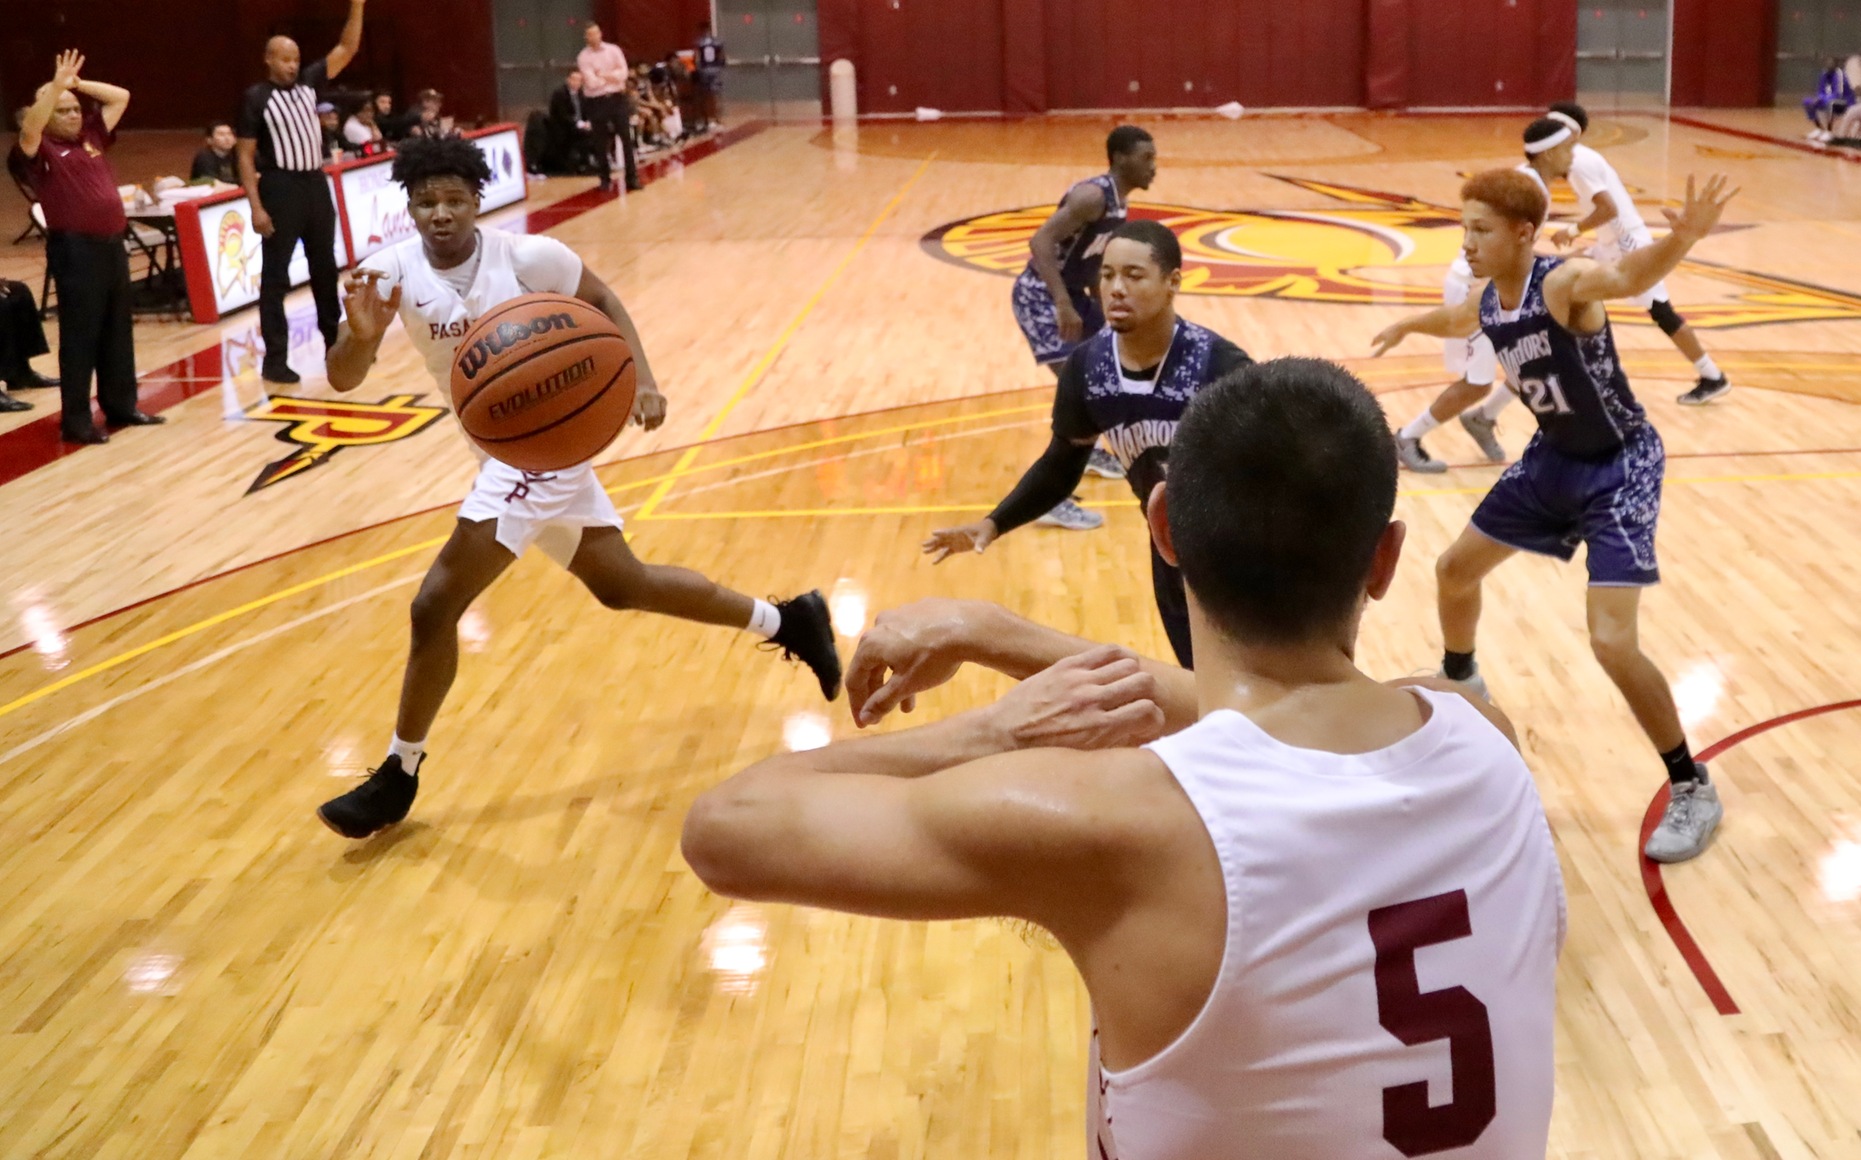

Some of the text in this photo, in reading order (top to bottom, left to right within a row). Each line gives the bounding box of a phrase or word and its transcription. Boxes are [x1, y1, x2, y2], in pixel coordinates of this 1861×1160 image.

[428, 318, 478, 341] PASA
[457, 312, 580, 380] Wilson
[488, 355, 597, 421] EVOLUTION
[1521, 374, 1575, 414] 21
[504, 481, 530, 504] P
[1367, 888, 1496, 1158] 5
